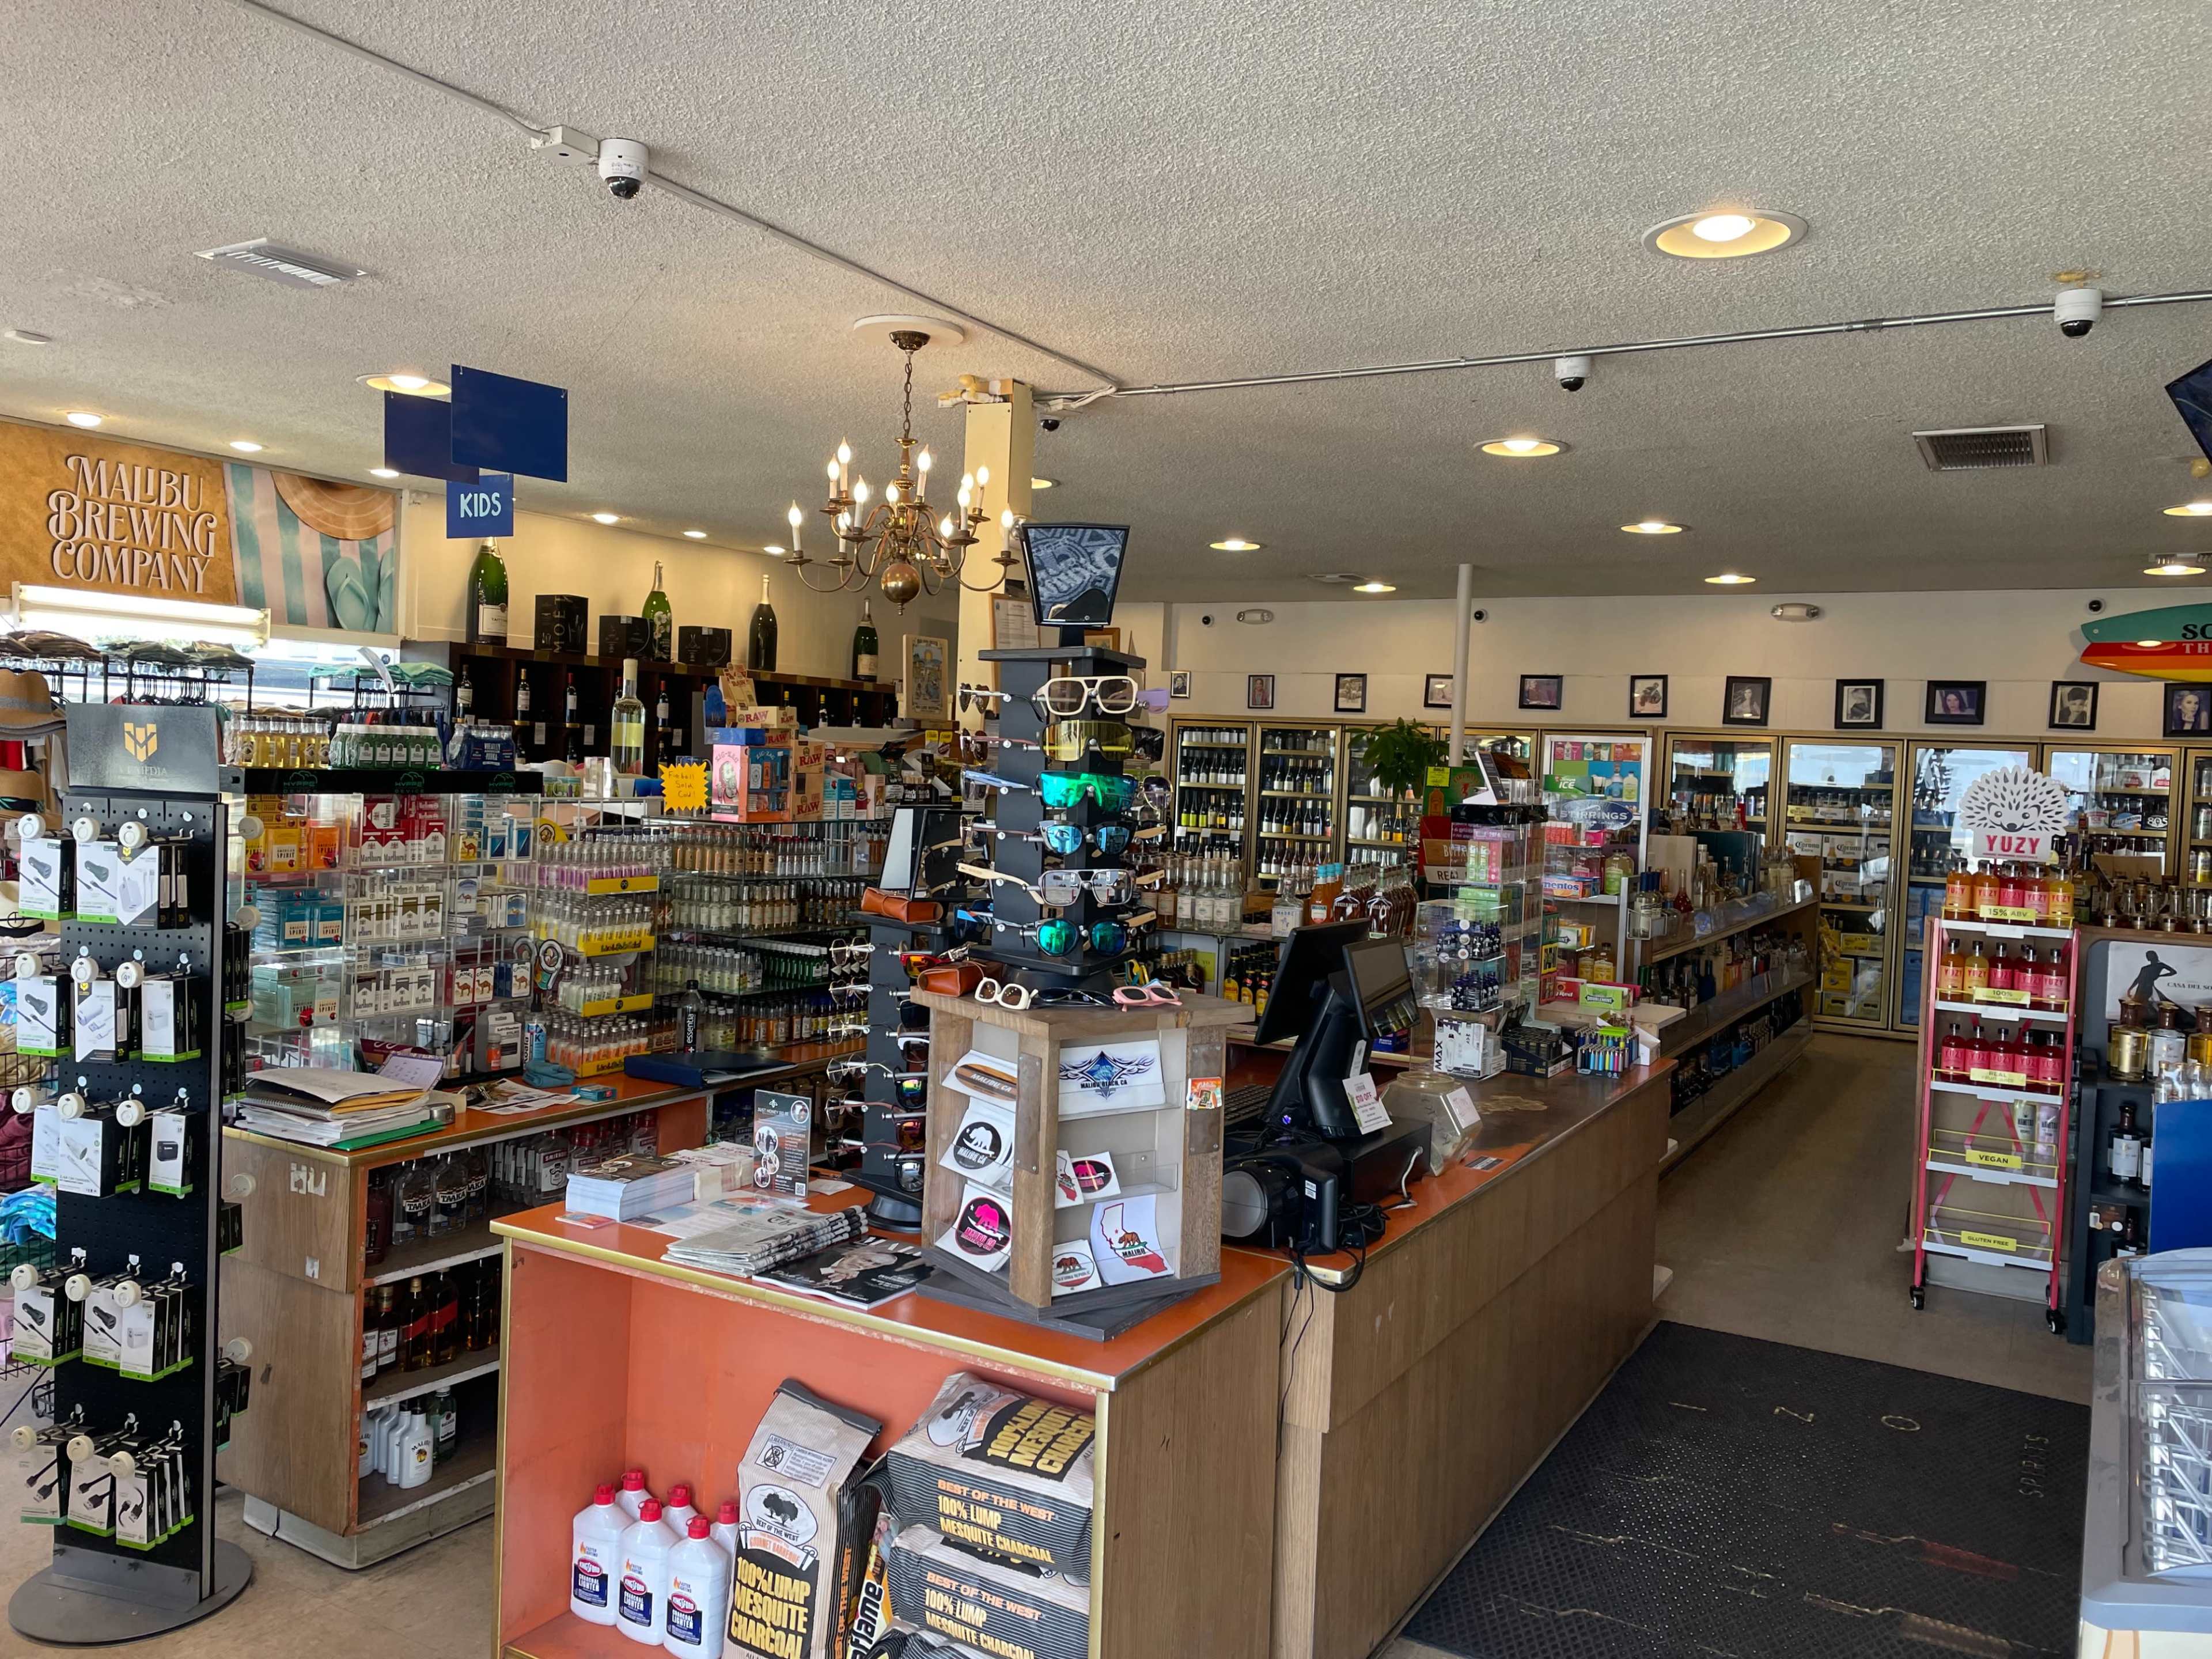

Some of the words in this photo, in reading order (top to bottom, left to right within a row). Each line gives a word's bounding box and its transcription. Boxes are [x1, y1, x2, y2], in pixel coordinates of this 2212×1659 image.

[65, 455, 204, 514] MALIBU
[459, 492, 502, 518] KIDS
[48, 490, 218, 559] BREWING
[52, 540, 211, 594] COMPANY
[732, 679, 747, 687] RAW
[745, 710, 770, 724] RAW
[781, 715, 794, 724] RAW
[767, 730, 790, 744] RAW
[756, 751, 775, 760] ZIG-ZAG
[799, 753, 822, 767] RAW
[797, 802, 820, 815] RAW
[383, 804, 391, 828] Marlboro
[1560, 811, 1628, 820] STIRRINGS
[2126, 815, 2142, 823] MOON
[2147, 816, 2168, 825] 805
[426, 844, 444, 855] Marlboro
[1836, 843, 1861, 851] Corona
[1987, 835, 2040, 854] YUZY
[360, 852, 381, 862] Marlboro
[384, 852, 404, 862] Marlboro
[1835, 879, 1861, 887] Corona
[1948, 886, 1965, 894] YUZY
[1978, 889, 1997, 897] YUZY
[2000, 891, 2022, 899] YUZY
[2028, 894, 2047, 902] YUZY
[2051, 894, 2071, 902] YUZY
[1988, 908, 2008, 916] 15%
[400, 921, 418, 930] Marlboro
[423, 918, 440, 928] Marlboro
[352, 926, 372, 937] Mrlboro
[513, 963, 529, 972] CAMEL
[1967, 969, 1987, 978] YUZY
[2044, 978, 2064, 986] YUZY
[2166, 982, 2186, 990] CASA
[393, 997, 410, 1006] Marlboro
[415, 993, 432, 1004] Marlboro
[1586, 996, 1613, 1004] DOUBLEMINT
[355, 1001, 373, 1009] Marlboro
[1435, 1040, 1443, 1070] MAX
[1001, 1083, 1013, 1093] CA
[1363, 1092, 1373, 1101] OFF
[978, 1155, 988, 1166] CA
[1979, 1154, 2009, 1165] VEGAN
[440, 1191, 467, 1203] TAAKA
[407, 1199, 431, 1211] TAAKA
[1967, 1236, 1992, 1244] GLUTEN
[1993, 1239, 2009, 1247] FREE
[1122, 1247, 1147, 1258] MALIBU
[987, 1419, 1024, 1459] 100%
[411, 1440, 432, 1452] MALIBU
[937, 1479, 969, 1497] BEST
[971, 1489, 990, 1502] OF
[991, 1495, 1018, 1511] THE
[1020, 1501, 1055, 1522] WEST
[938, 1494, 967, 1520] 100%
[969, 1503, 1002, 1531] LUMP
[756, 1520, 767, 1532] BEST
[767, 1524, 773, 1533] OF
[773, 1526, 783, 1537] THE
[783, 1529, 800, 1542] WEST
[940, 1517, 994, 1547] MESQUITE
[995, 1534, 1055, 1563] CHARCOAL
[578, 1573, 600, 1585] CHARCOAL
[578, 1580, 600, 1592] LIGHTER
[624, 1590, 644, 1604] CHARCOAL
[927, 1571, 959, 1591] BEST
[960, 1584, 979, 1598] OF
[981, 1590, 1003, 1608] THE
[1006, 1600, 1042, 1622] WEST
[624, 1597, 644, 1611] LIGHTER
[673, 1597, 695, 1610] KINGSFORD
[734, 1581, 808, 1634] MESQUITE
[925, 1588, 954, 1618] 100%
[955, 1600, 987, 1628] LUMP
[672, 1609, 693, 1622] CHARCOAL
[672, 1615, 694, 1630] LIGHTER
[730, 1610, 804, 1659] CHARCOAL
[925, 1610, 978, 1645] MESQUITE
[979, 1631, 1035, 1659] CHARCOAL
